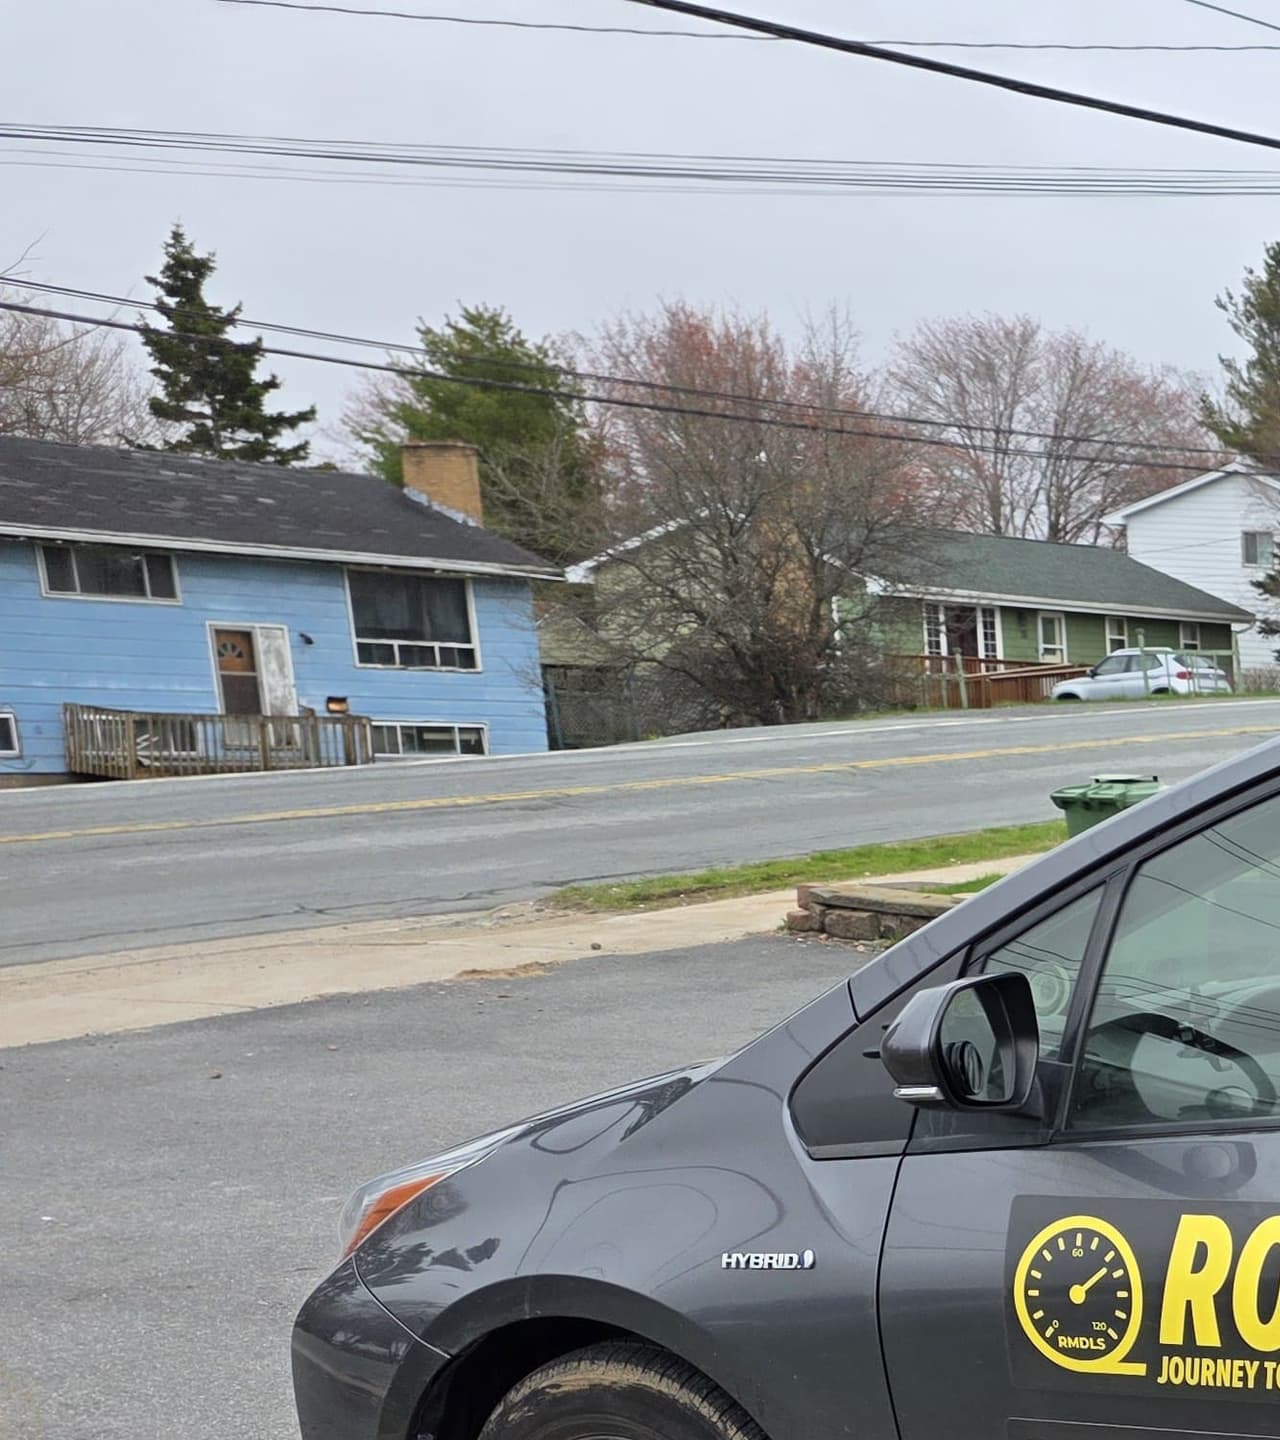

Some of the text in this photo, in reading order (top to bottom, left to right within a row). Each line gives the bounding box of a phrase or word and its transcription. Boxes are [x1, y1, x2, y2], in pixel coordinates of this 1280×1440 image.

[721, 1252, 799, 1269] HYBRID
[1071, 1248, 1084, 1258] 60
[1091, 1321, 1107, 1331] 120
[1057, 1335, 1106, 1350] RMDLS
[1157, 1355, 1260, 1388] JOURNEY
